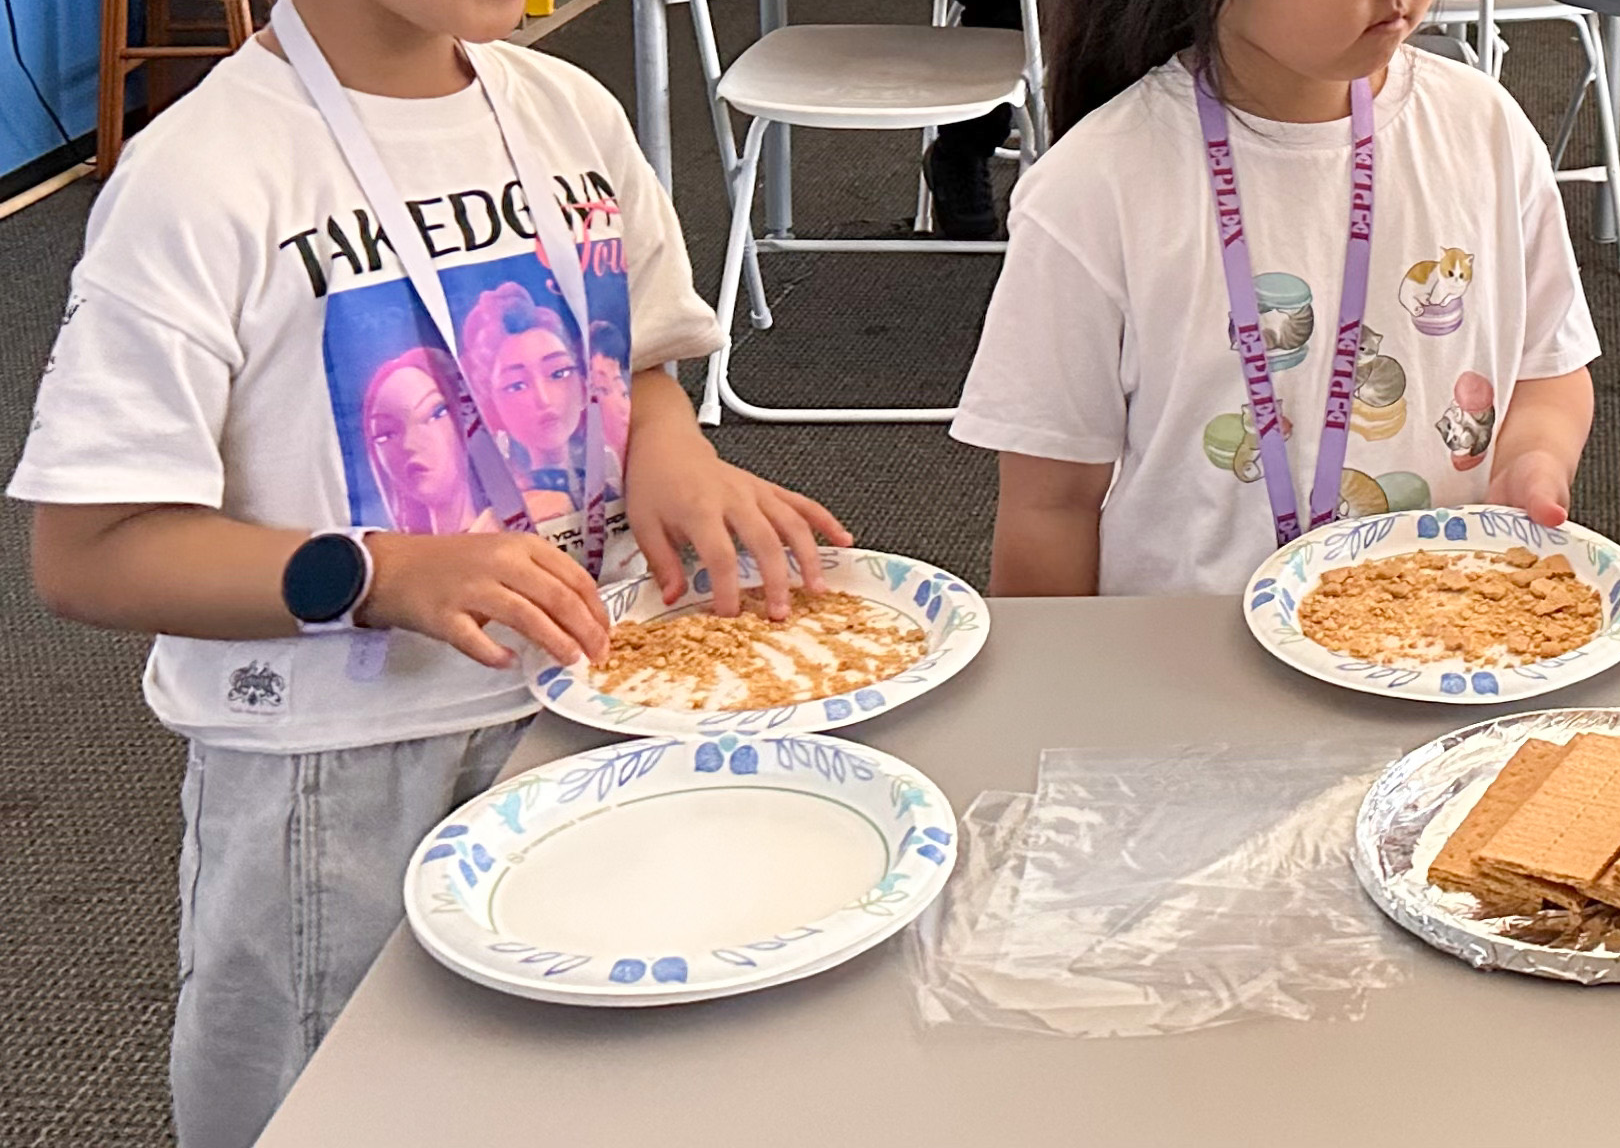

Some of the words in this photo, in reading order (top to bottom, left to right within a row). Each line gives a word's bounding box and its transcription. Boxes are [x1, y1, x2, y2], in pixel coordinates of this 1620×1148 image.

[1208, 140, 1246, 249] E-PLEX
[1350, 135, 1373, 242] E-PLEX
[1238, 324, 1281, 439] E-PLEX
[1325, 320, 1361, 430] E-PLEX
[552, 527, 582, 542] YOU
